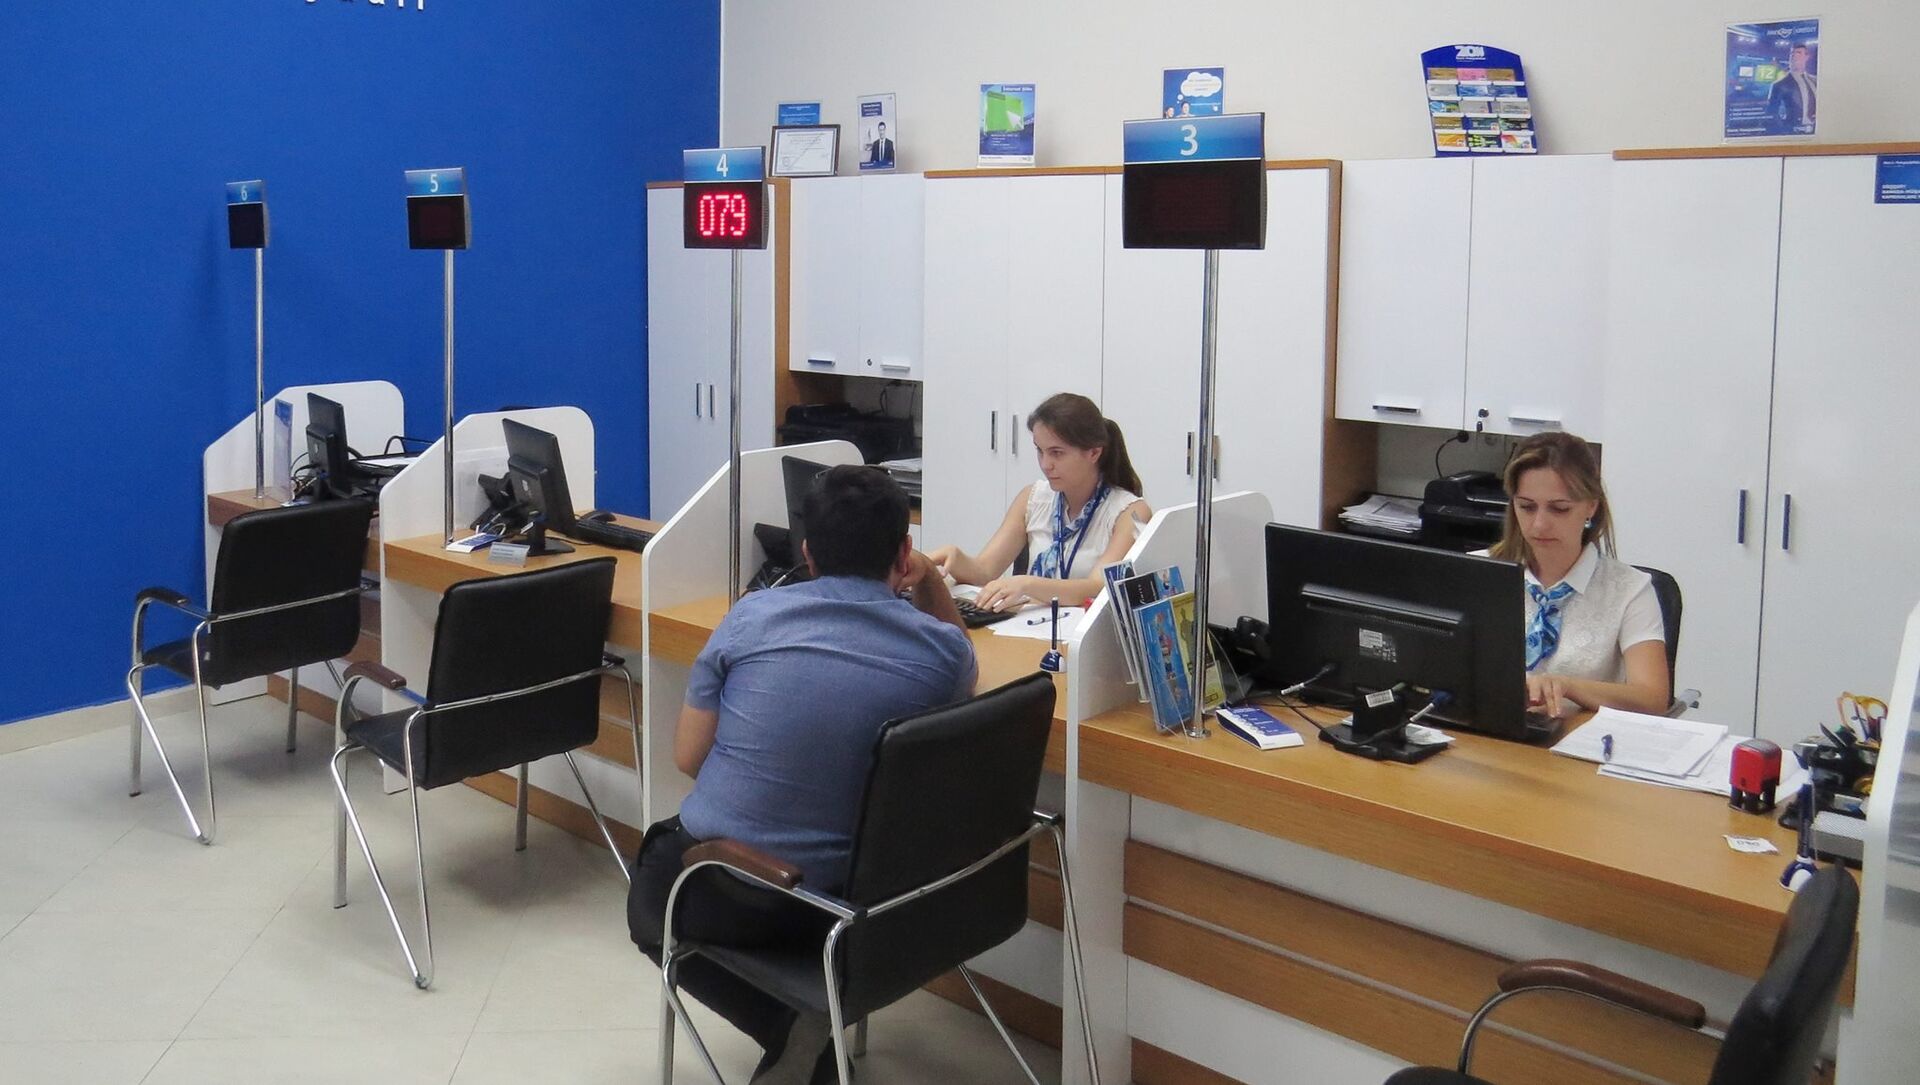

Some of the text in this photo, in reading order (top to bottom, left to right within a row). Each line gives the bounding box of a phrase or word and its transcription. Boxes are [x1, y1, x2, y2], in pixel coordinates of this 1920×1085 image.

[1180, 124, 1199, 156] 3
[716, 153, 729, 178] 4
[241, 185, 248, 201] 6
[430, 173, 439, 193] 5
[699, 194, 746, 236] 079
